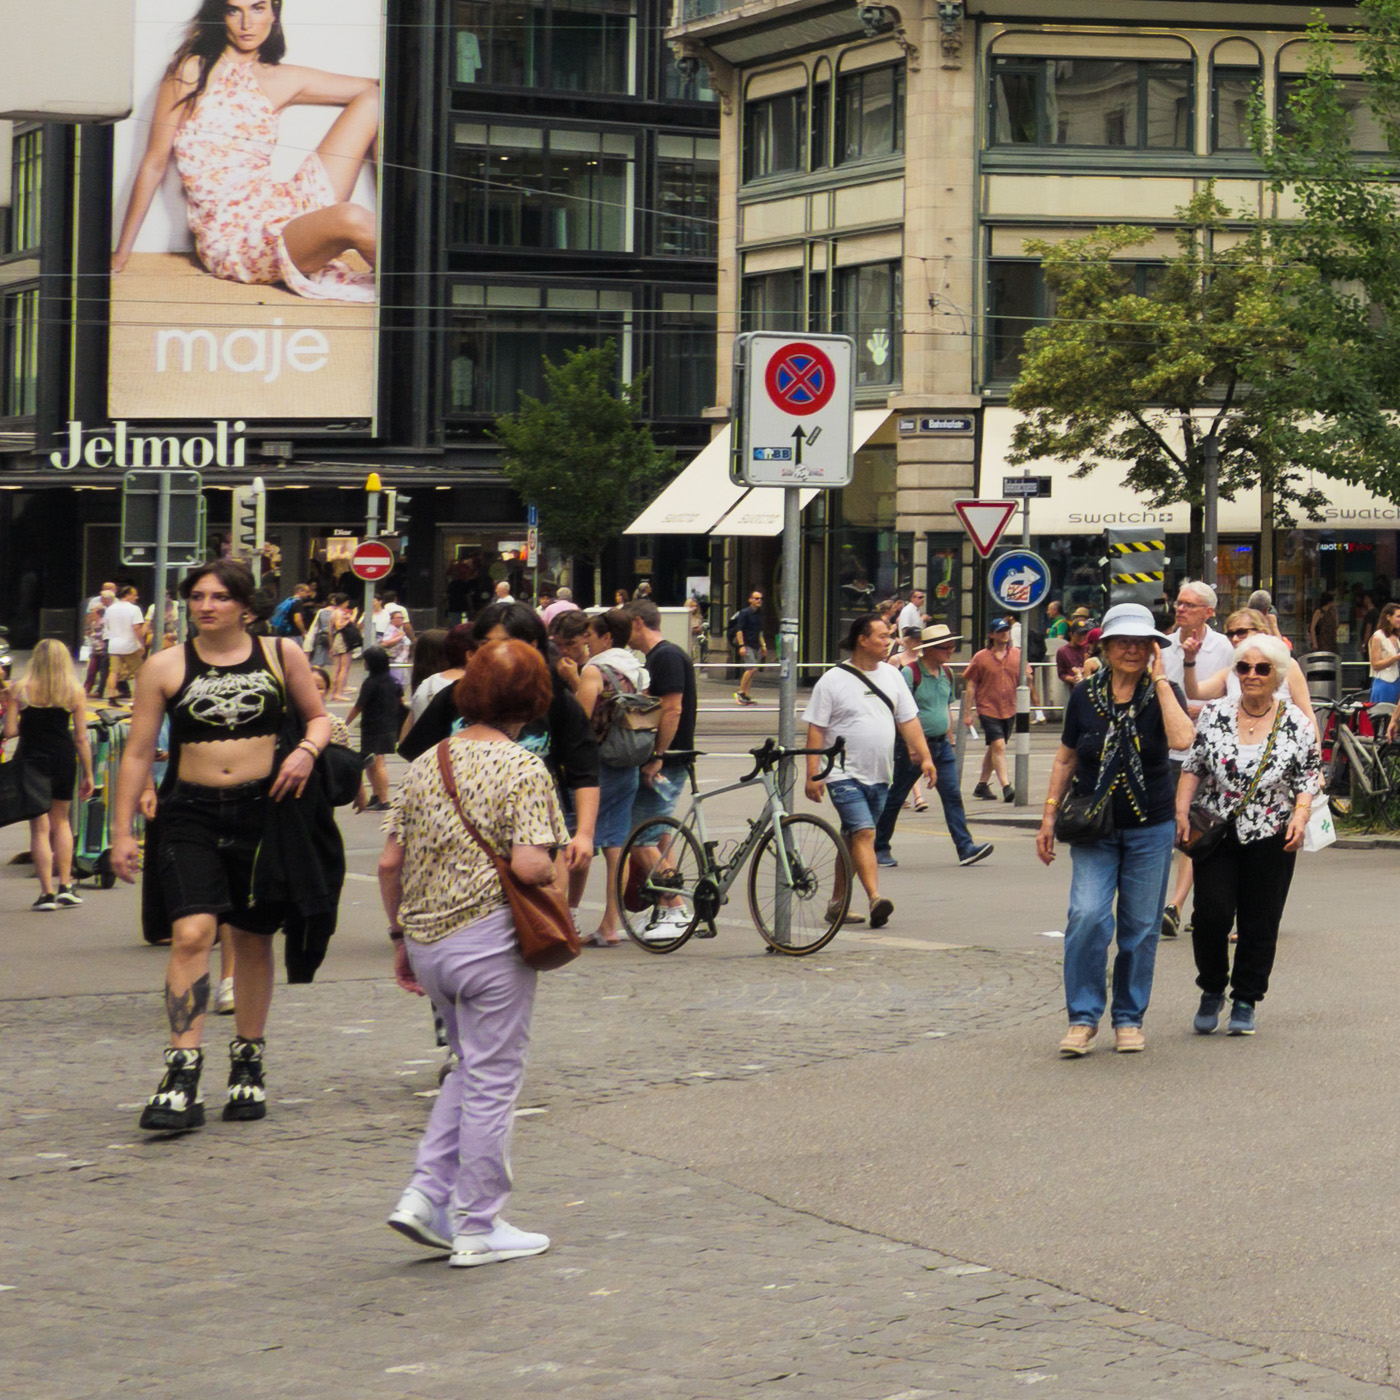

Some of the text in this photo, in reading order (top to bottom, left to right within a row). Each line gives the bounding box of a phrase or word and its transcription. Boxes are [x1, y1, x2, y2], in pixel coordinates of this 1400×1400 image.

[156, 317, 329, 383] maje
[50, 420, 246, 470] Jelmoli
[1068, 511, 1157, 524] swatch
